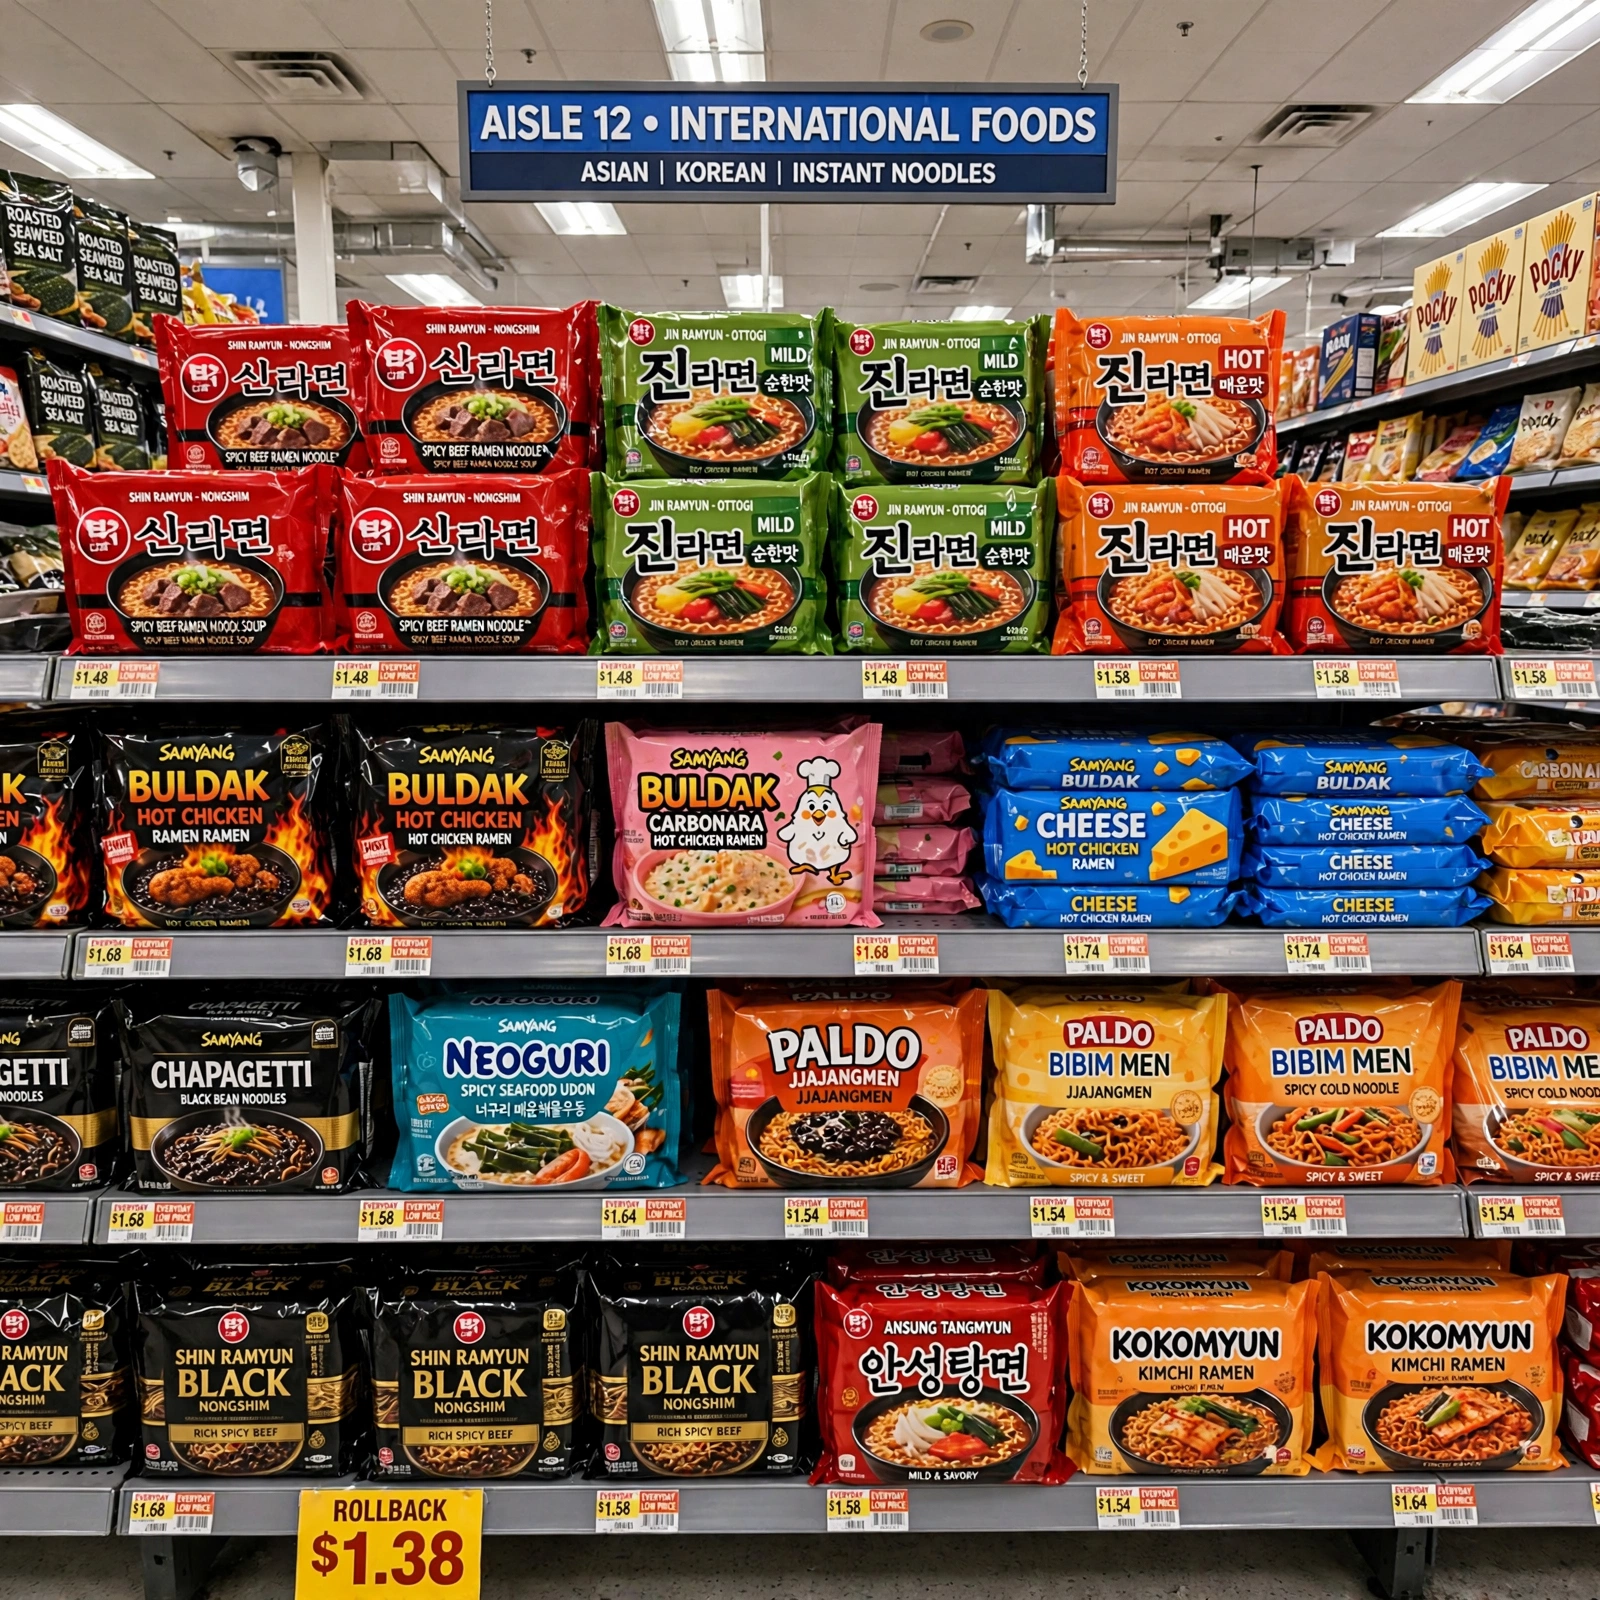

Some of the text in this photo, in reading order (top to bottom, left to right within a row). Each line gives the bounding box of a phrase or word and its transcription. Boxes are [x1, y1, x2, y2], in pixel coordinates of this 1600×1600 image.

[480, 105, 1096, 143] AISLE 12 INTERNATIONAL FOODS
[581, 162, 996, 184] ASIAN KOREAN INSTANT NOODLES
[7, 206, 62, 230] ROASTED
[8, 224, 64, 246] SEAWEED
[79, 232, 123, 255] ROASTED
[14, 241, 63, 263] SEA SALT
[79, 248, 124, 271] SEAWEED
[134, 255, 175, 275] ROASTED
[84, 266, 123, 286] SEA SALT
[135, 271, 178, 292] SEAWEED
[139, 287, 177, 307] SEA SALT
[426, 324, 540, 334] SHIN RAMYUN NONGSHIM
[664, 329, 766, 341] JIN RAMYUN OTTOGI
[228, 341, 331, 350] SHIN RAMYUN NONGSHIM
[771, 347, 807, 363] MILD
[430, 343, 558, 390] 신라면
[638, 345, 758, 403] 진라면
[39, 374, 82, 394] ROASTED
[232, 358, 350, 400] 신라면
[764, 374, 812, 393] 순한맛
[41, 391, 85, 409] SEAWEED
[45, 407, 84, 425] SEA SALT
[133, 511, 273, 560] 신라면
[1228, 519, 1270, 538] HOT
[1453, 518, 1490, 537] HOT
[406, 511, 542, 561] 신라면
[1096, 518, 1218, 577] 진라면
[1322, 516, 1442, 575] 진라면
[1224, 546, 1271, 564] 매운맛
[1448, 546, 1490, 564] 매운맛
[75, 670, 108, 685] $1.48
[335, 670, 369, 685] $1.48
[600, 671, 632, 684] $1.48
[865, 671, 897, 684] $1.48
[1097, 671, 1130, 684] $1.58
[1316, 671, 1349, 684] $1.58
[1514, 672, 1546, 684] $1.58
[159, 743, 235, 762] SAMYANG
[418, 746, 495, 765] SAMYANG
[671, 748, 748, 769] SAMYANG
[1070, 758, 1135, 773] SAMYANG
[1325, 760, 1387, 774] SAMYANG
[129, 770, 270, 803] BULDAK
[388, 773, 529, 805] BULDAK
[1062, 775, 1140, 788] BULDAK
[1316, 776, 1391, 790] BULDAK
[638, 773, 780, 811] BULDAK
[1061, 797, 1127, 810] SAMYANG
[137, 807, 262, 825] HOT CHICKEN
[649, 814, 764, 832] CARBONARA
[1036, 812, 1146, 838] CHEESE
[152, 829, 250, 843] RAMEN RAMEN
[408, 833, 511, 845] HOT CHICKEN RAMEN
[653, 834, 763, 847] HOT CHICKEN RAMEN
[1047, 843, 1139, 855] HOT CHICKEN
[1072, 858, 1114, 870] RAMEN
[393, 939, 428, 947] EVERYDAY
[1287, 944, 1320, 958] $1.74
[1490, 944, 1524, 958] $1.64
[89, 947, 121, 962] $1.68
[349, 947, 381, 961] $1.68
[393, 947, 429, 956] LOW PRICE
[609, 946, 641, 960] $1.68
[856, 945, 889, 959] $1.68
[1067, 944, 1100, 959] $1.74
[498, 1019, 557, 1034] SAMYANG
[1067, 1021, 1152, 1047] PALDO
[1298, 1018, 1382, 1043] PALDO
[201, 1032, 263, 1048] SAMYANG
[768, 1024, 920, 1073] PALDO
[443, 1037, 610, 1079] NEOGURI
[1049, 1052, 1170, 1076] BIBIM MEN
[1272, 1047, 1412, 1075] BIBIM MEN
[151, 1060, 313, 1088] CHAPAGETTI
[789, 1069, 899, 1089] JJAJANGMEN
[461, 1083, 595, 1096] SPICY SEAFOOD UDON
[1067, 1086, 1152, 1099] JJAJANGMEN
[1285, 1082, 1399, 1096] SPICY COLD NOODLE
[180, 1093, 286, 1105] BLACK BEAN NOODLES
[796, 1091, 892, 1105] JJAJANGMEN
[476, 1102, 511, 1117] 너구리
[1070, 1173, 1146, 1183] SPICY & SWEET
[112, 1212, 144, 1228] $1.68
[361, 1211, 395, 1226] $1.58
[604, 1210, 637, 1224] $1.64
[787, 1208, 819, 1223] $1.54
[1033, 1207, 1066, 1221] $1.54
[1264, 1207, 1297, 1221] $1.54
[1481, 1207, 1515, 1221] $1.54
[884, 1320, 1012, 1334] ANSUNG TANGMYUN
[1110, 1327, 1282, 1362] KOKOMYUN
[1366, 1320, 1534, 1354] KOKOMYUN
[175, 1349, 293, 1365] SHIN RAMYUN
[859, 1342, 1030, 1396] 안성탕면
[1139, 1366, 1254, 1380] KIMCHI RAMEN
[177, 1368, 290, 1397] BLACK
[200, 1401, 269, 1412] NONGSHIM
[194, 1427, 278, 1439] RICH SPICY BEEF
[908, 1470, 978, 1480] MILD & SAVORY
[133, 1502, 165, 1518] $1.68
[334, 1499, 447, 1522] ROLLBACK
[598, 1502, 630, 1516] $1.58
[829, 1501, 860, 1515] $1.58
[1099, 1498, 1130, 1514] $1.54
[1395, 1495, 1427, 1510] $1.64
[311, 1530, 464, 1586] $1.38
